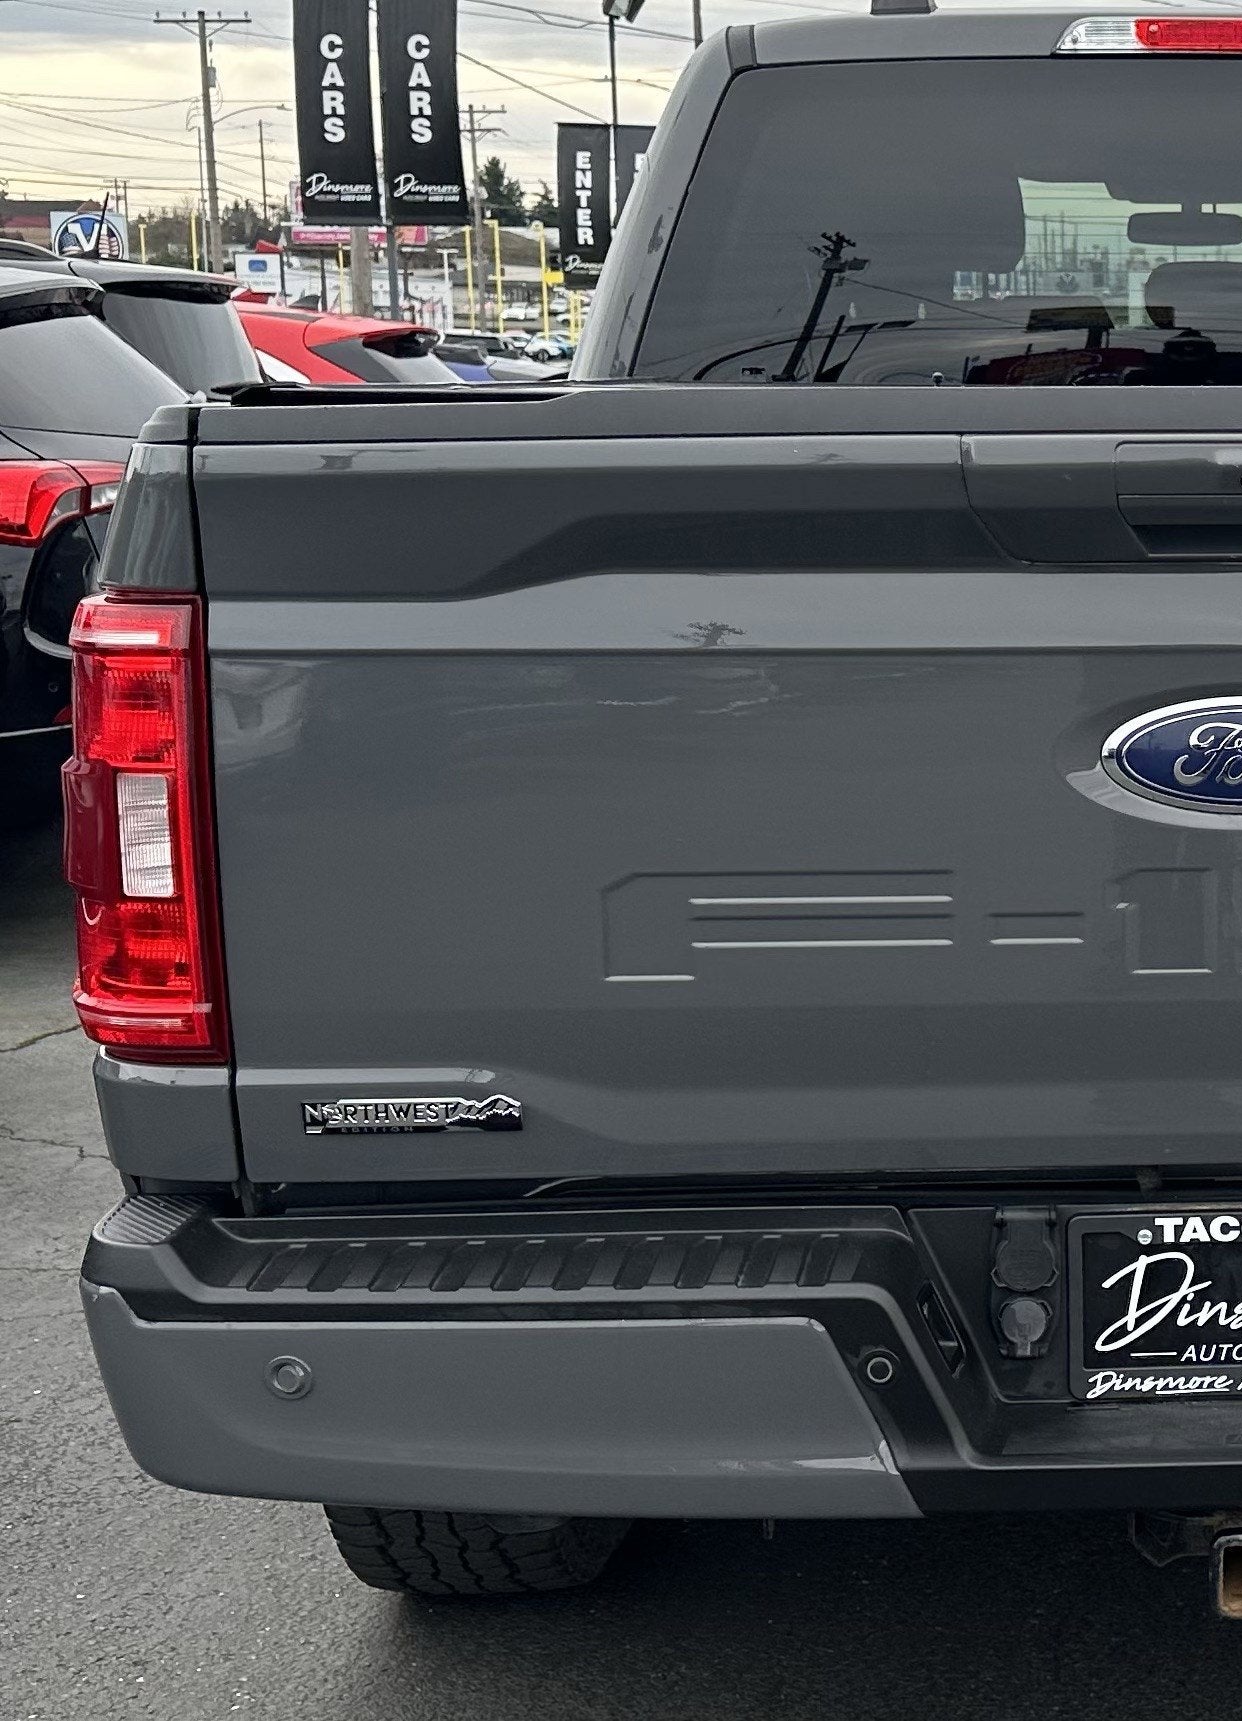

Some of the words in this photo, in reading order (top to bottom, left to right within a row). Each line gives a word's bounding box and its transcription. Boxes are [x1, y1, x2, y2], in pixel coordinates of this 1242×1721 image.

[320, 33, 346, 143] CARS
[406, 33, 433, 144] CARS
[575, 150, 594, 245] ENTER
[304, 1103, 456, 1124] NORTHWEST
[1086, 1371, 1233, 1398] Dinsmore
